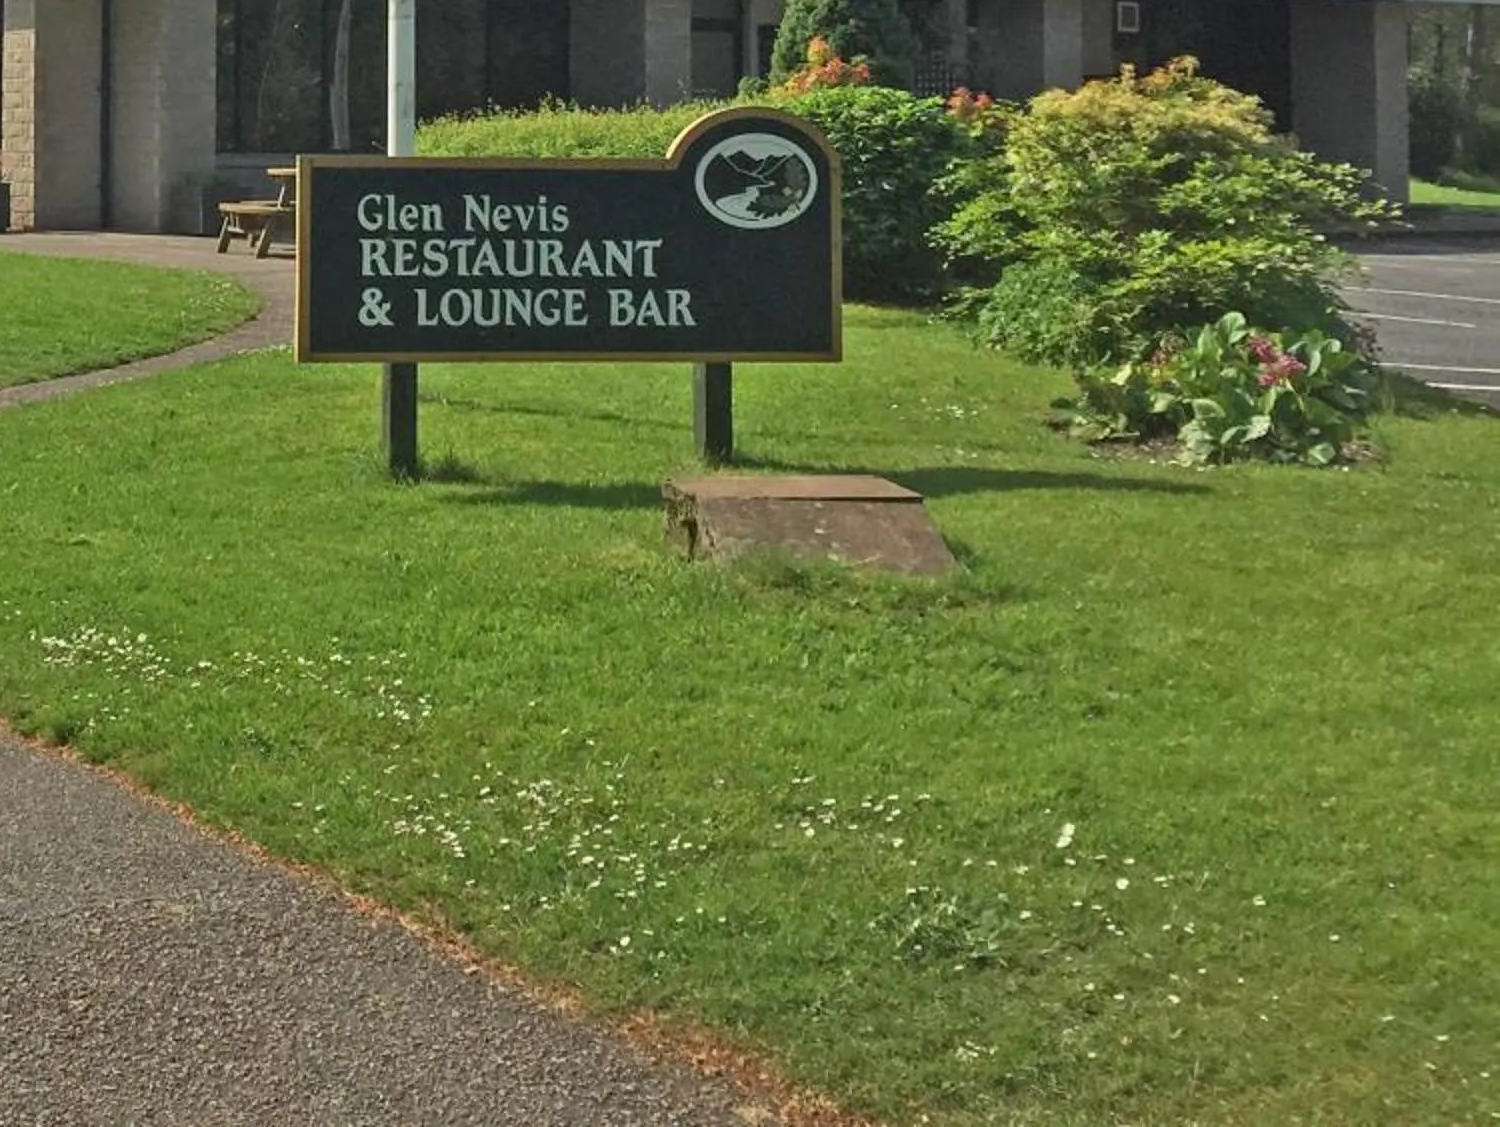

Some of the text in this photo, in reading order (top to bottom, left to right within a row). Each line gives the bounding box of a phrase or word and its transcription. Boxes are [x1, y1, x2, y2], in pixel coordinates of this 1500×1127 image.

[357, 194, 570, 233] Glen Nevis
[359, 238, 663, 277] RESTAURANT
[358, 287, 697, 327] & LOUNGE BAR
